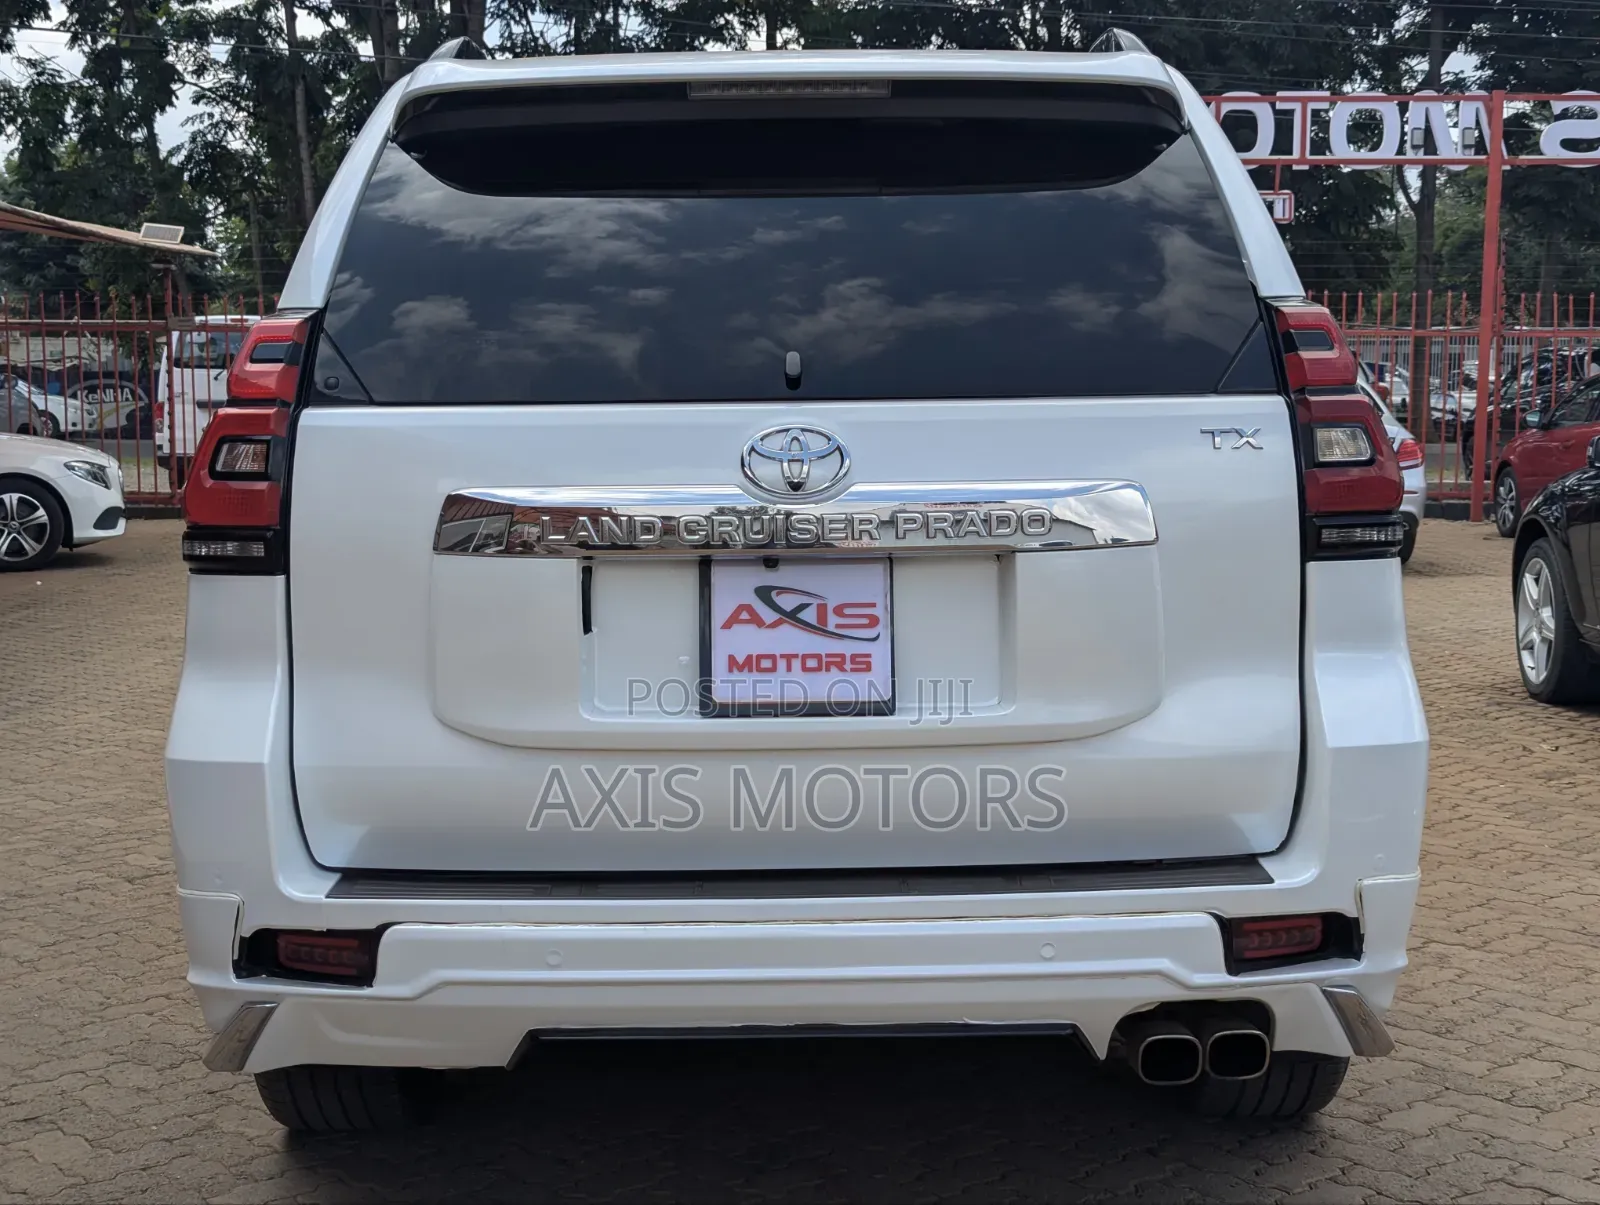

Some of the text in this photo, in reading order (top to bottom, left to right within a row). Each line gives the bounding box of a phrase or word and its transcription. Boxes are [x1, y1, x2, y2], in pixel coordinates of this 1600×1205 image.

[1200, 427, 1263, 450] TX
[540, 508, 1053, 545] LAND CRUISER PRADO
[720, 593, 881, 636] AXIS
[728, 653, 872, 673] MOTORS
